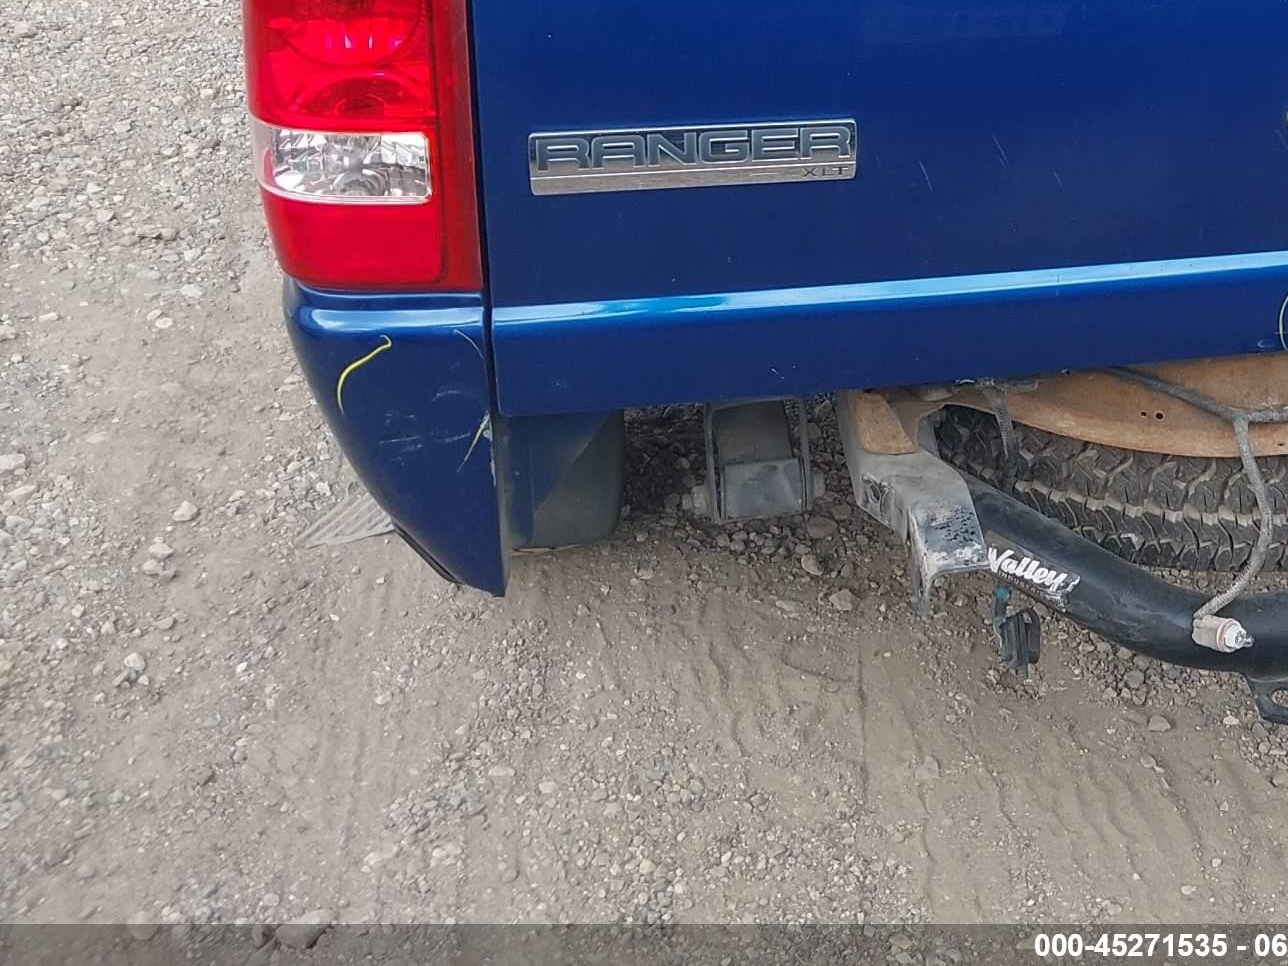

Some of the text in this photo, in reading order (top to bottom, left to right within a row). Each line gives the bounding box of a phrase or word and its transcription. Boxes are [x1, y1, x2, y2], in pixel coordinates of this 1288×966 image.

[535, 126, 851, 171] RANGER
[801, 166, 850, 179] XLT
[988, 546, 1068, 592] Valley
